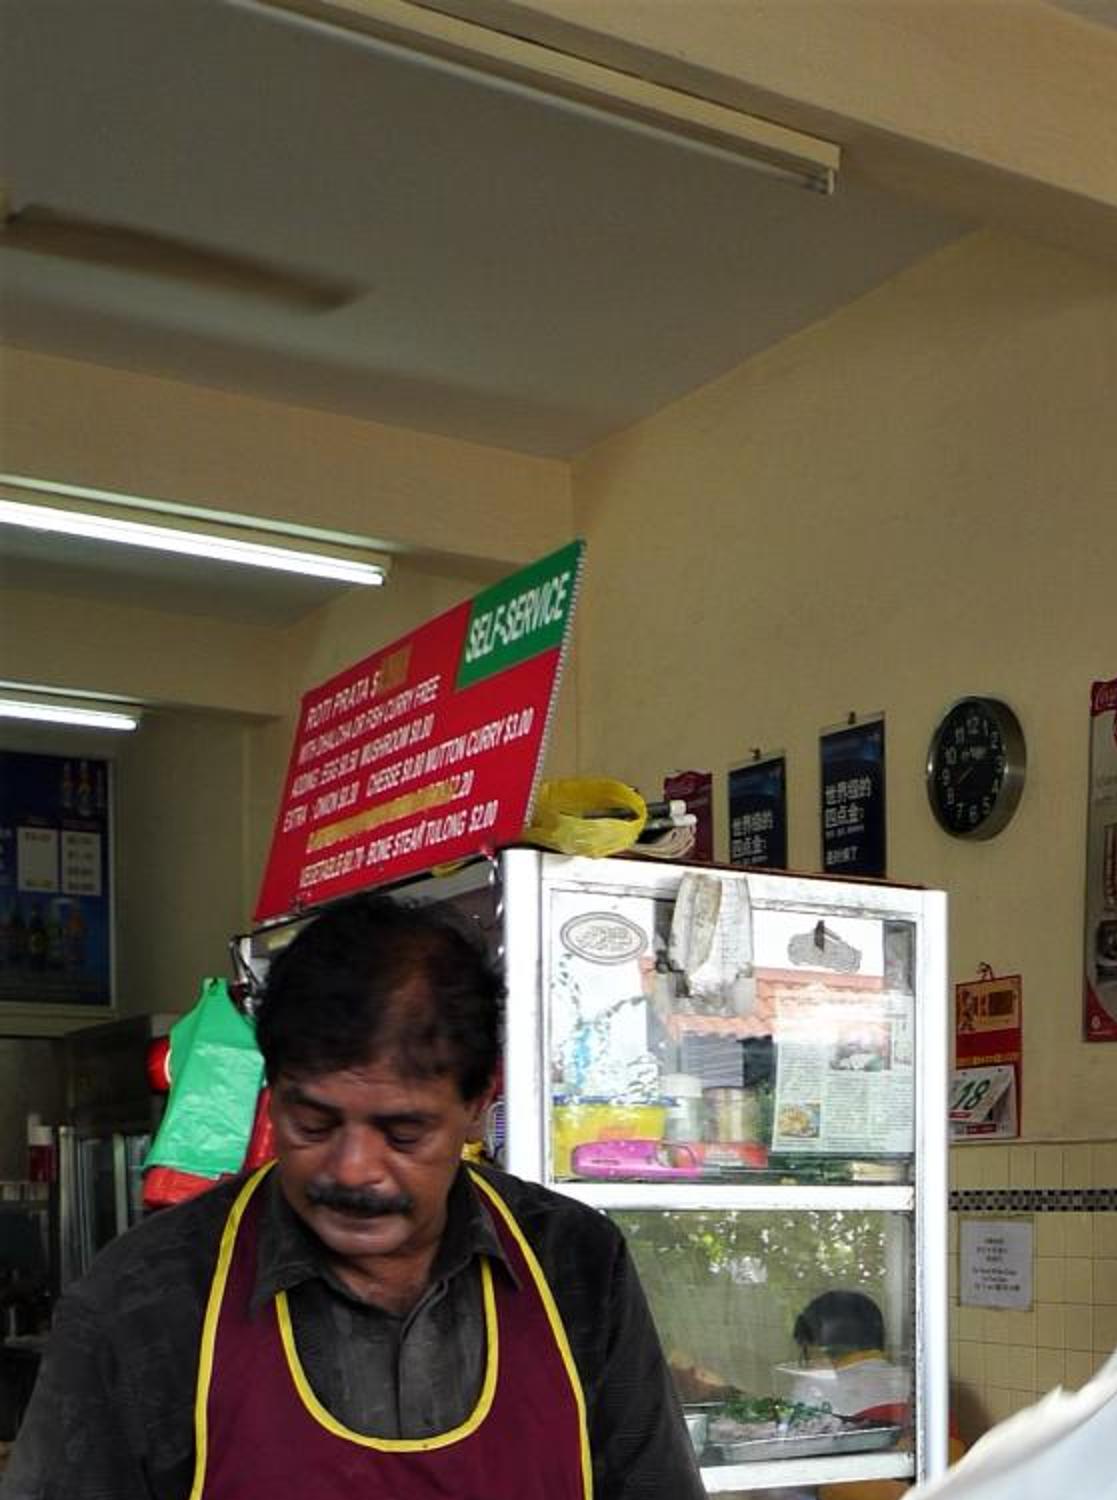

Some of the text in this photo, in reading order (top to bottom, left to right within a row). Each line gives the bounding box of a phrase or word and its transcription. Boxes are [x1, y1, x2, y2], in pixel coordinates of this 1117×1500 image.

[465, 571, 570, 662] SELF-SERVICE
[306, 698, 332, 729] ROTI
[332, 678, 369, 716] PRATA
[414, 675, 440, 706] FREE
[424, 736, 465, 772] MUTTON
[465, 719, 504, 756] CURRY
[503, 707, 533, 741] $3.00
[425, 811, 466, 846] TULONG
[951, 1078, 990, 1110] 18
